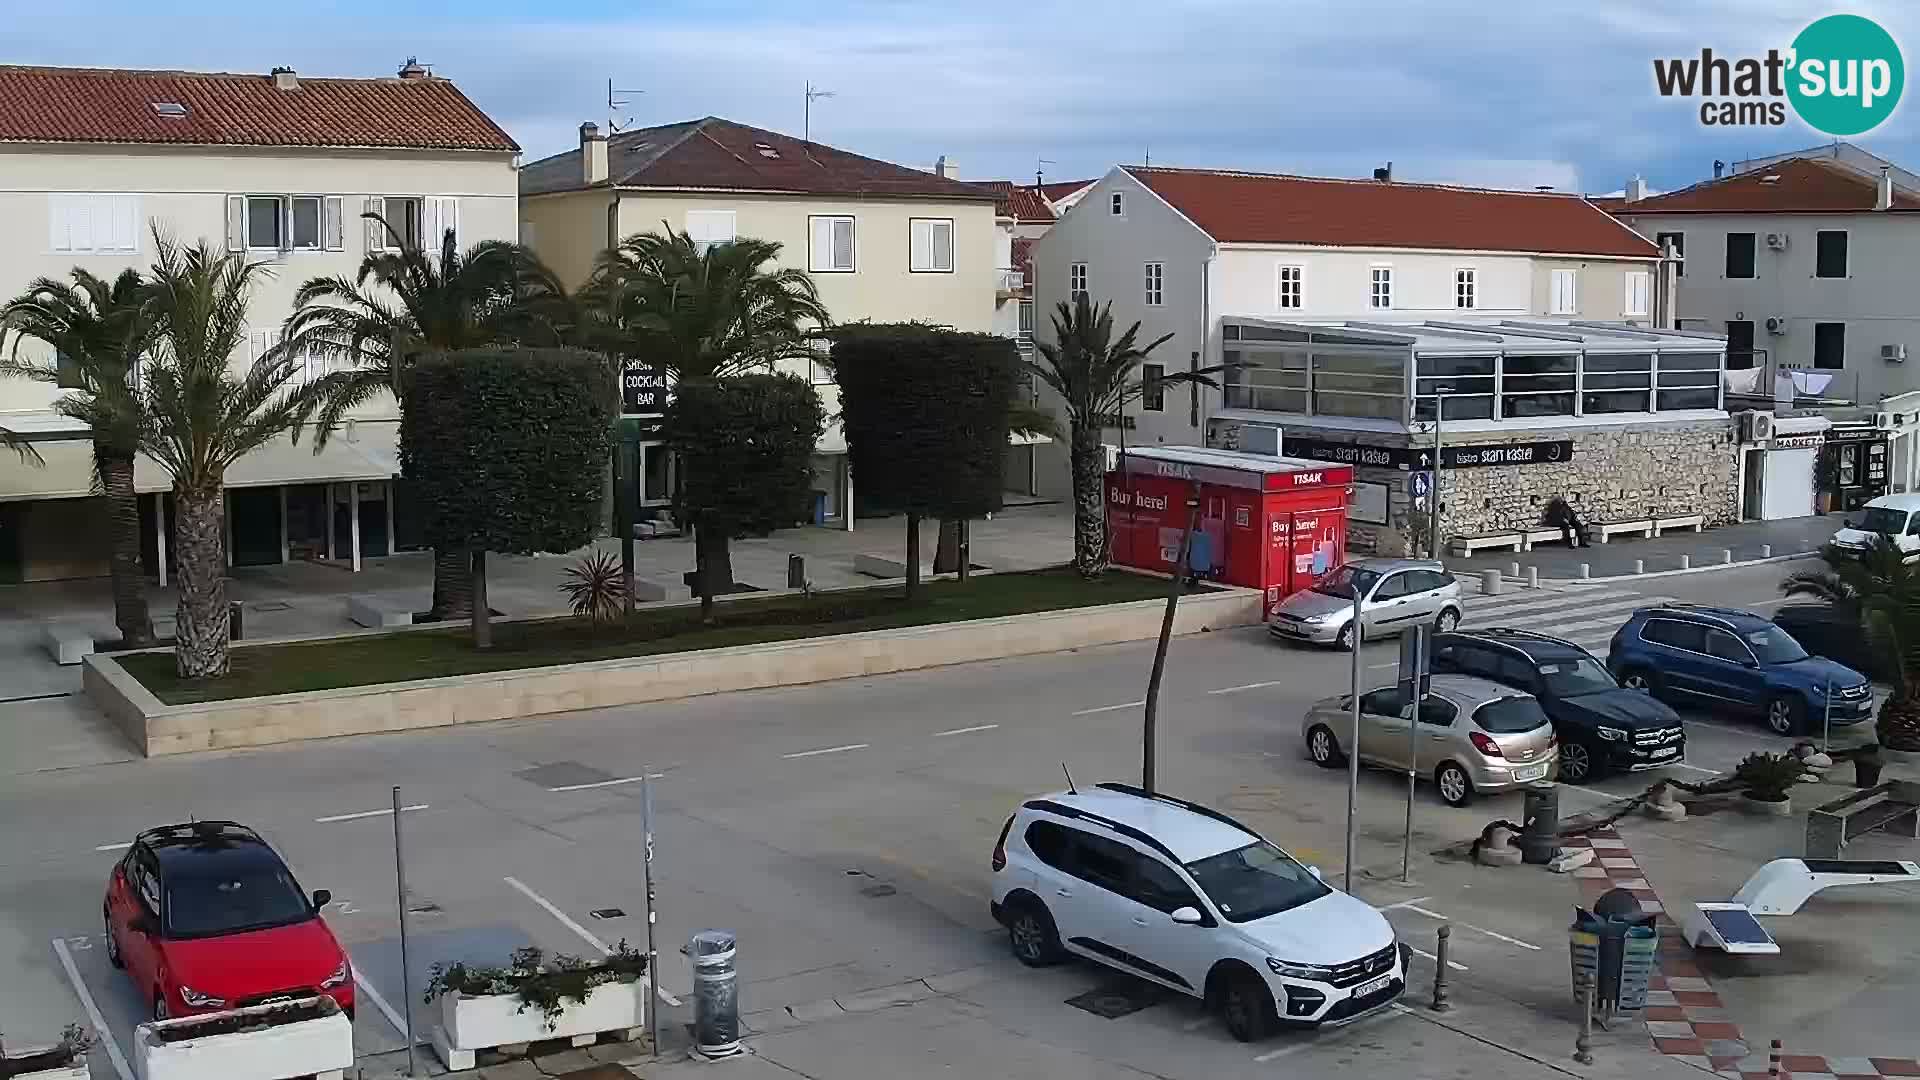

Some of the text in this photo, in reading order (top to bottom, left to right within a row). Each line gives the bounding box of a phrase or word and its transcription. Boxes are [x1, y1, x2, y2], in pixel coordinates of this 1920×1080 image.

[625, 375, 665, 388] COCKTAIL
[637, 392, 655, 405] BAR
[1293, 472, 1323, 485] TISAK
[1111, 486, 1168, 511] Buy here!
[1272, 517, 1319, 534] Buy here!
